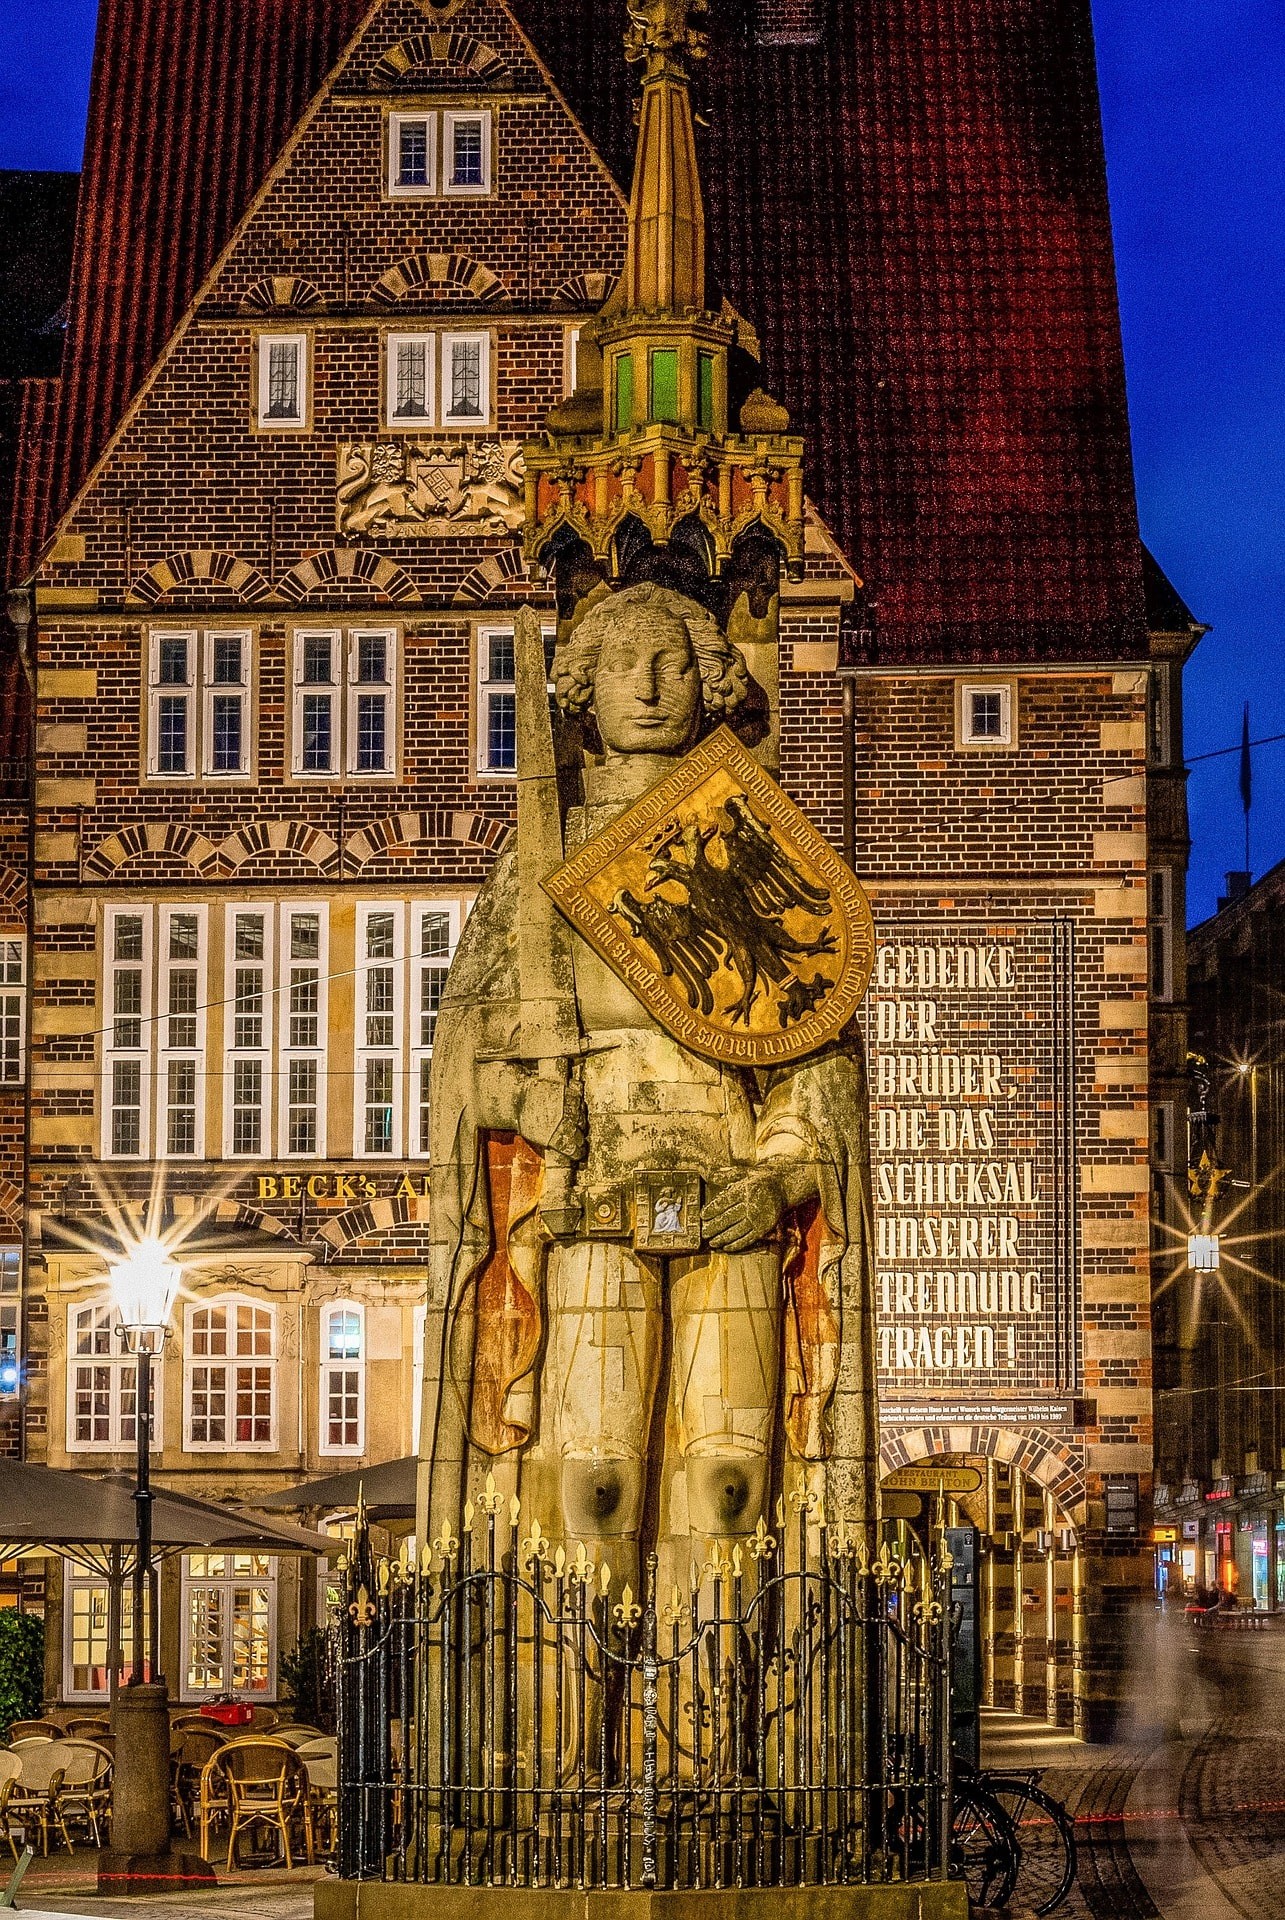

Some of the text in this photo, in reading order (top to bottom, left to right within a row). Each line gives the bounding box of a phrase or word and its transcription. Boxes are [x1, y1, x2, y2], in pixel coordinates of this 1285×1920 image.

[878, 945, 1016, 988] GEDENKE
[877, 1001, 938, 1042] DER
[877, 1046, 1018, 1099] BRÜDER,
[877, 1108, 995, 1151] DIE DAS
[877, 1162, 1040, 1205] SCHICKSAL
[877, 1217, 1020, 1259] UNSERER
[878, 1271, 1043, 1314] TRENNUNG
[878, 1326, 996, 1368] TRAGEN
[883, 1477, 916, 1487] JOHN
[897, 1469, 958, 1478] RESTAURANT
